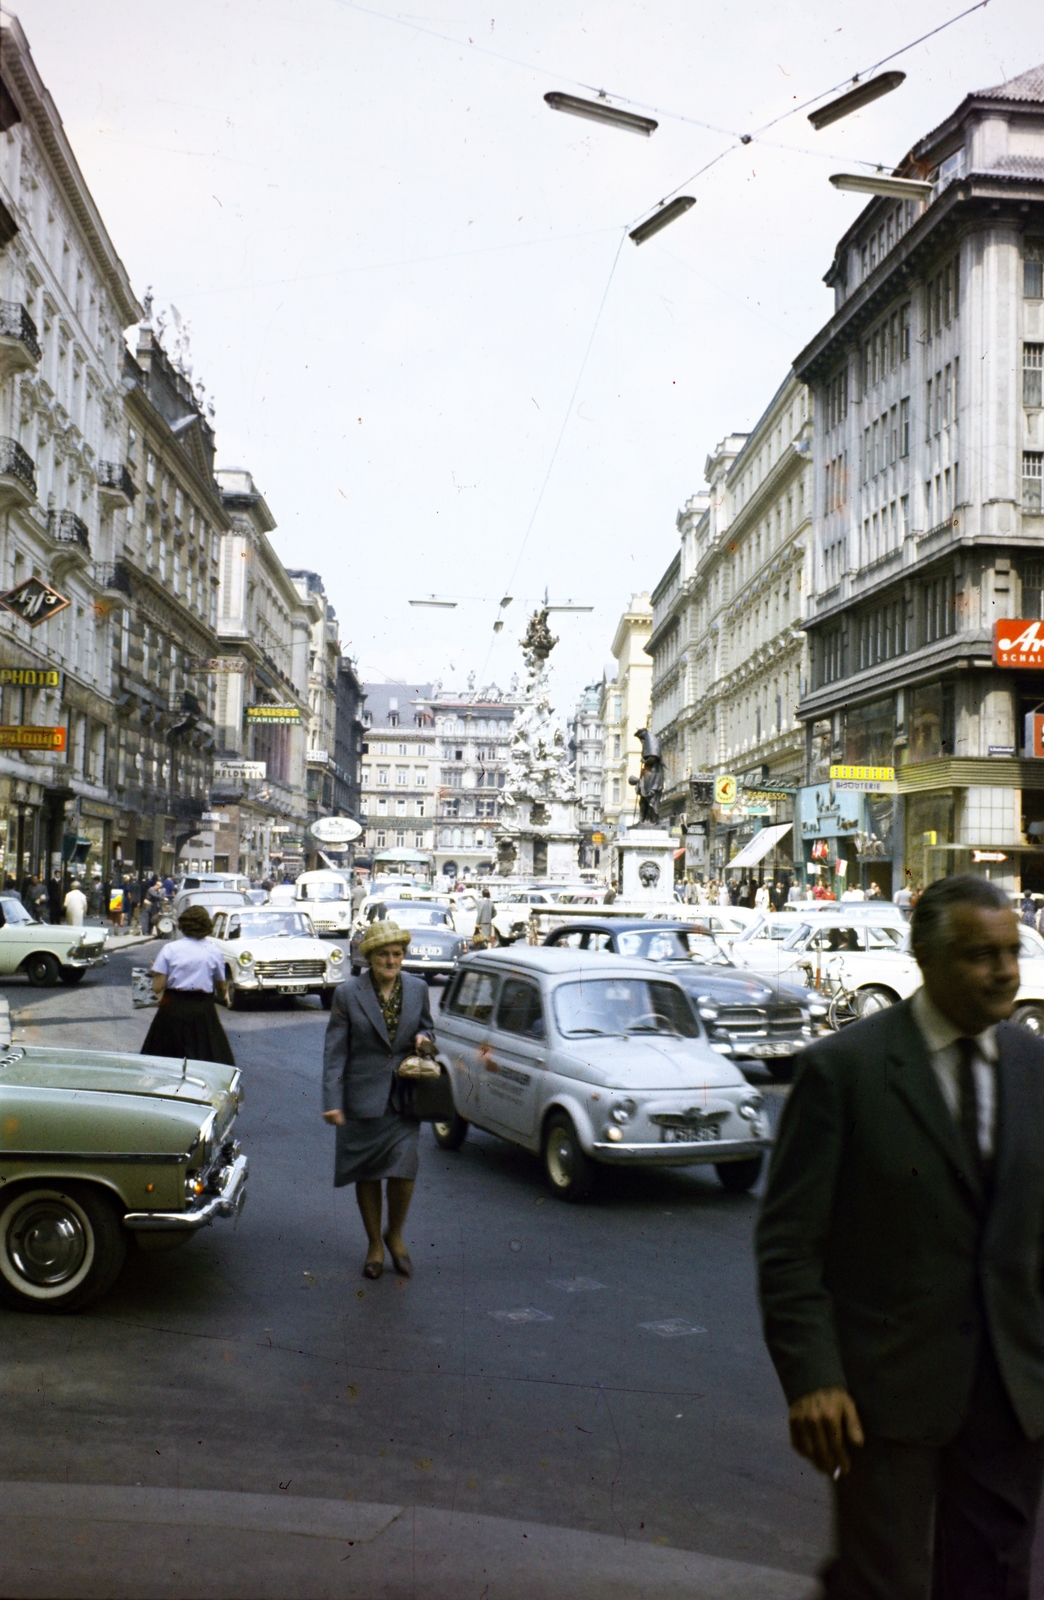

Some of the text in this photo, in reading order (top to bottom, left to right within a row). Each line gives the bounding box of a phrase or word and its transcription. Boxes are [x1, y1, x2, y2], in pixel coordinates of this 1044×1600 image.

[7, 588, 57, 617] Agfa
[1002, 653, 1042, 663] SCHAL
[1, 669, 58, 686] PHOTO
[247, 707, 300, 717] MAUSER
[215, 769, 264, 779] HELDWEIN
[835, 781, 880, 791] BIJOUTERIE
